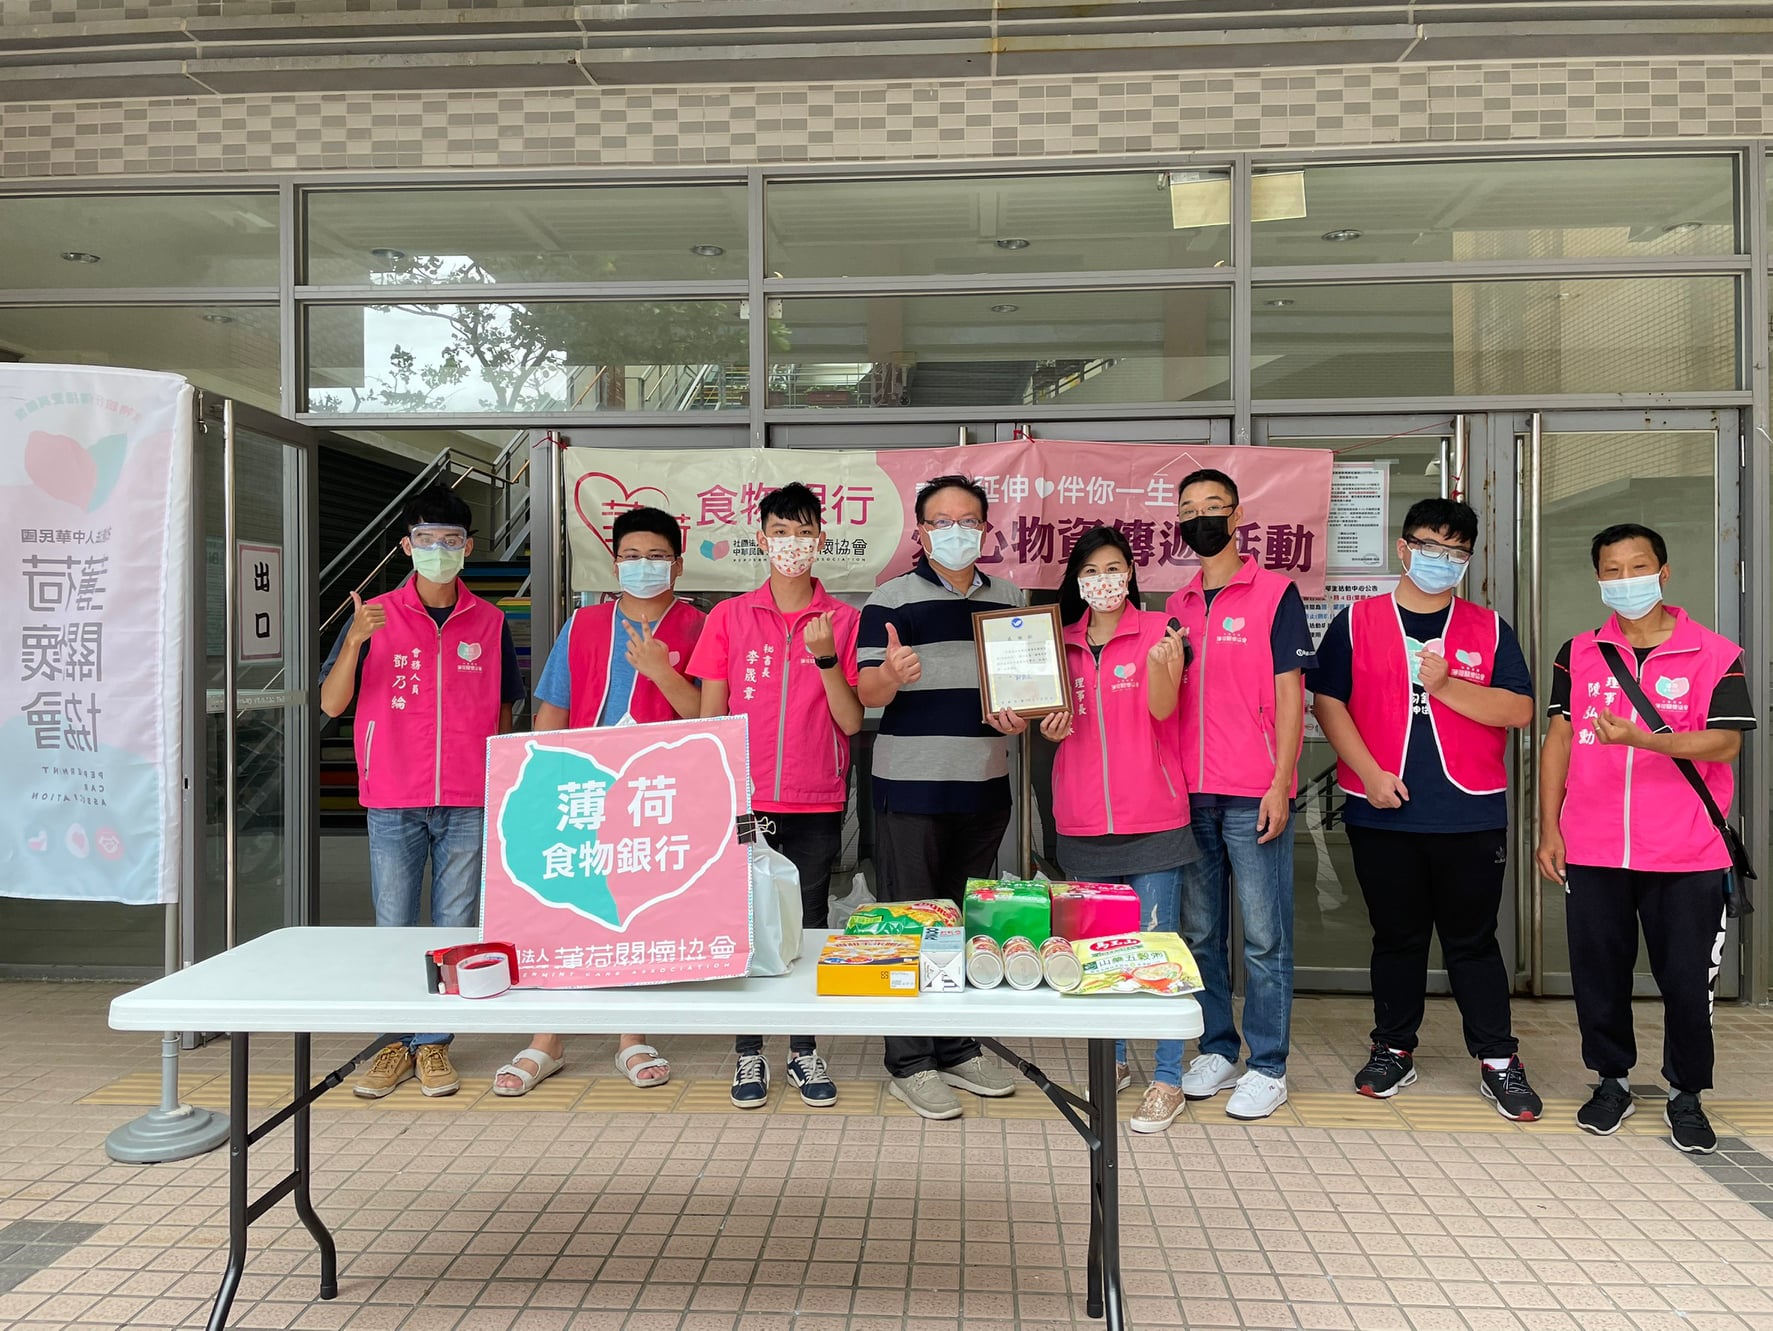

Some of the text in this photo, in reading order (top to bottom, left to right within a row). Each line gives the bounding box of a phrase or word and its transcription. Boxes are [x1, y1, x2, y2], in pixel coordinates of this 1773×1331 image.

[1057, 475, 1178, 507] 伴你一生
[733, 539, 760, 548] 社團法
[911, 515, 1315, 572] 心物資傳遞活動
[254, 561, 270, 638] 出口
[391, 654, 409, 710] 鄧乃綸
[410, 647, 422, 696] 會務人員
[761, 643, 775, 679] 秘書長
[1074, 676, 1087, 716] 理事長
[557, 774, 676, 832] 薄荷
[542, 834, 690, 880] 食物銀行
[516, 935, 737, 969] 法人 薄荷關懷協會
[631, 962, 731, 975] ASSOCIATION
